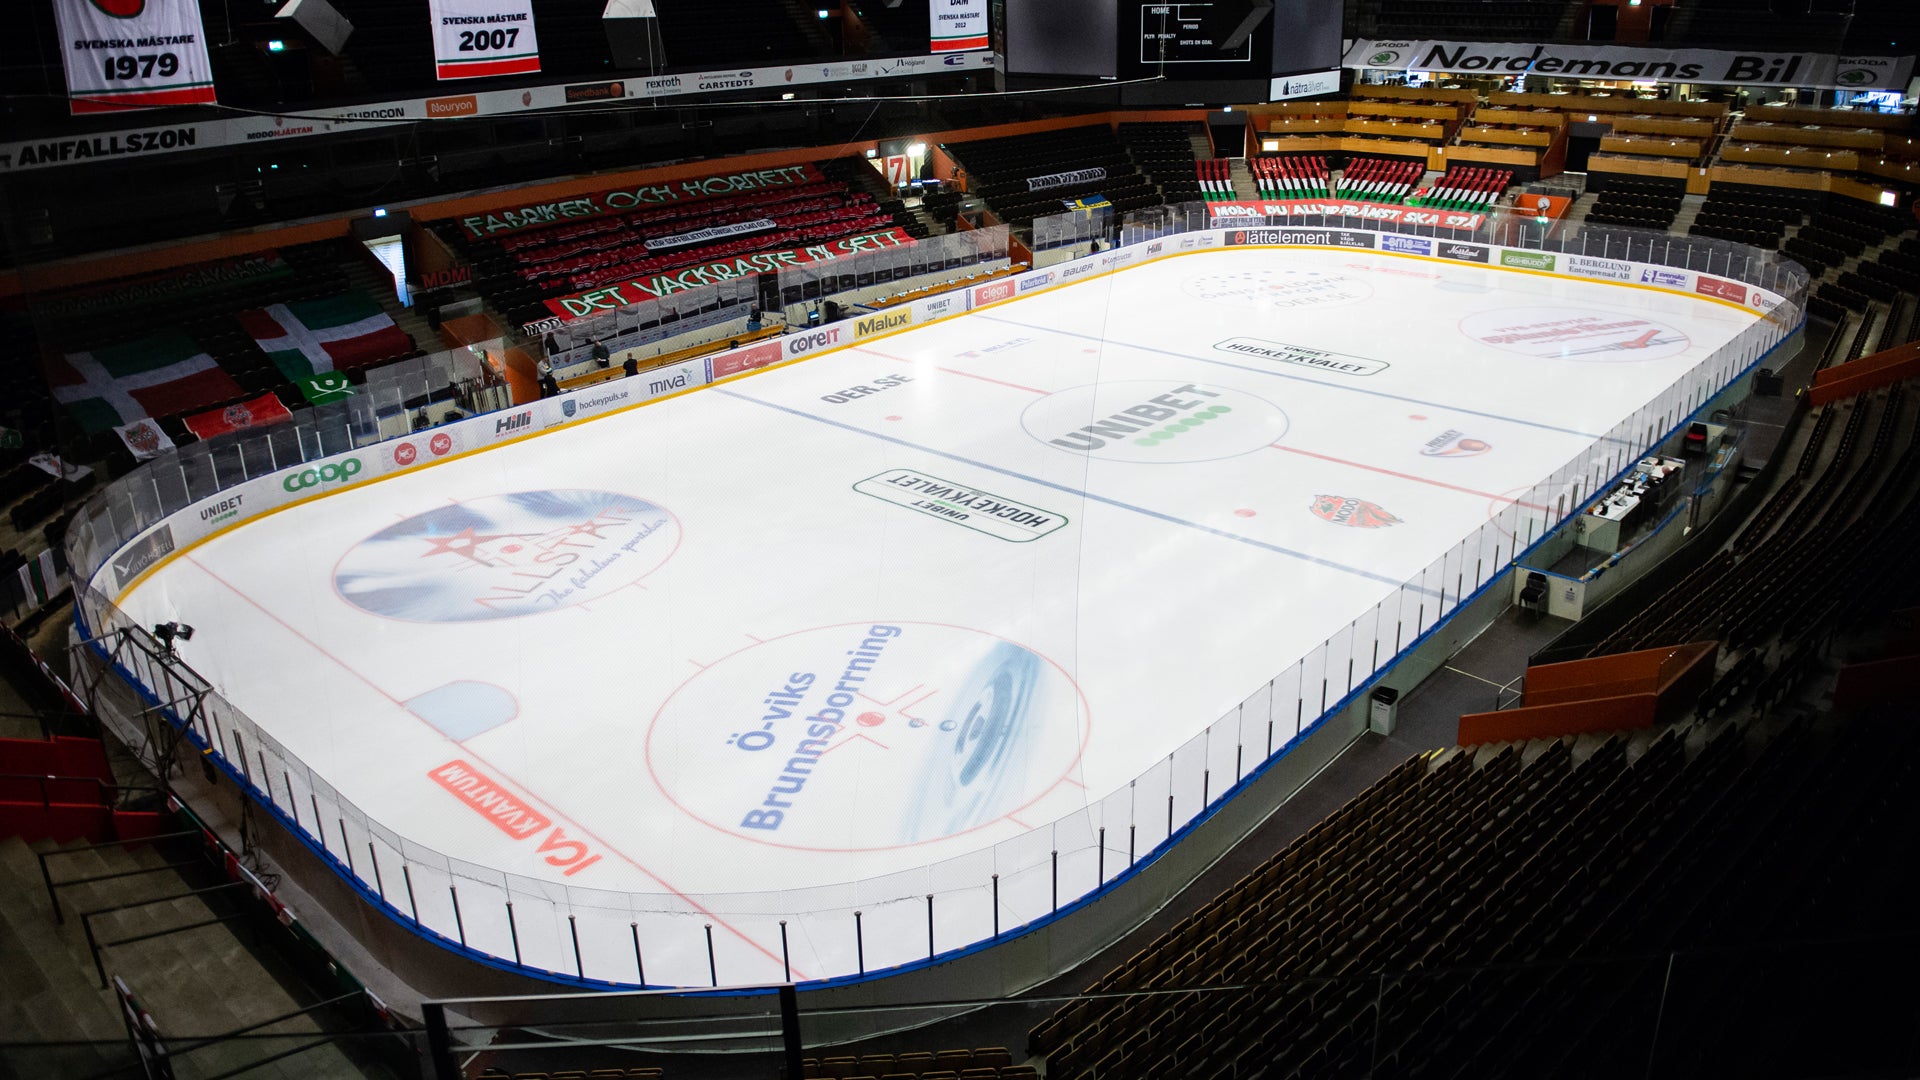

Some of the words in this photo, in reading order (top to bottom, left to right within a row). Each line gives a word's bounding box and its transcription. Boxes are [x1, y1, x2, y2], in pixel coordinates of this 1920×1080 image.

[443, 16, 485, 25] SVENSKA
[487, 13, 527, 24] MÄSTARE
[74, 39, 135, 50] SVENSKA
[136, 34, 194, 48] MÄSTARE
[459, 28, 519, 51] 2007
[105, 53, 178, 80] 1979
[1420, 44, 1704, 80] Nordemans
[1723, 56, 1802, 82] Bil
[567, 86, 610, 98] Swedbank
[646, 76, 681, 88] rexroth
[699, 79, 754, 90] CARSTEDTS
[431, 100, 473, 113] Nouryon
[18, 127, 195, 167] ANFALLSZON
[889, 158, 904, 185] 7
[462, 197, 601, 238] FABRIKEN
[605, 186, 679, 209] OCH
[1264, 205, 1288, 216] DU
[1340, 205, 1402, 220] FRÄMST
[1404, 211, 1439, 224] SKA
[1445, 213, 1480, 229] STÅ
[1246, 230, 1330, 245] lättelement
[561, 286, 629, 318] DET
[804, 245, 837, 262] NI
[838, 230, 904, 252] SETT
[1063, 263, 1094, 277] BAUER
[1569, 266, 1616, 278] Entreprenad
[1619, 272, 1630, 280] AB
[1580, 258, 1631, 272] BERGLUND
[927, 299, 950, 311] UNIBET
[858, 312, 907, 336] Malux
[790, 328, 840, 354] coreIT
[1284, 346, 1331, 358] UNIBET
[1227, 342, 1368, 374] HOCKEYKVALET
[649, 374, 686, 395] miva
[820, 373, 916, 405] OER.SE
[579, 391, 629, 411] hockeypuls.se
[496, 410, 532, 434] Hilli
[1048, 383, 1221, 451] UNIBET
[283, 458, 362, 492] coop
[200, 494, 243, 521] UNIBET
[887, 474, 1051, 528] HOCKEYKVALET
[911, 498, 970, 522] UNIBET
[535, 587, 574, 606] The
[570, 552, 622, 590] fabulous
[620, 518, 668, 553] sportsbar
[726, 671, 816, 751] Ö-viks
[740, 624, 903, 831] Brunnsborrning
[438, 764, 541, 834] KVANTUM
[535, 826, 603, 877] ICA
